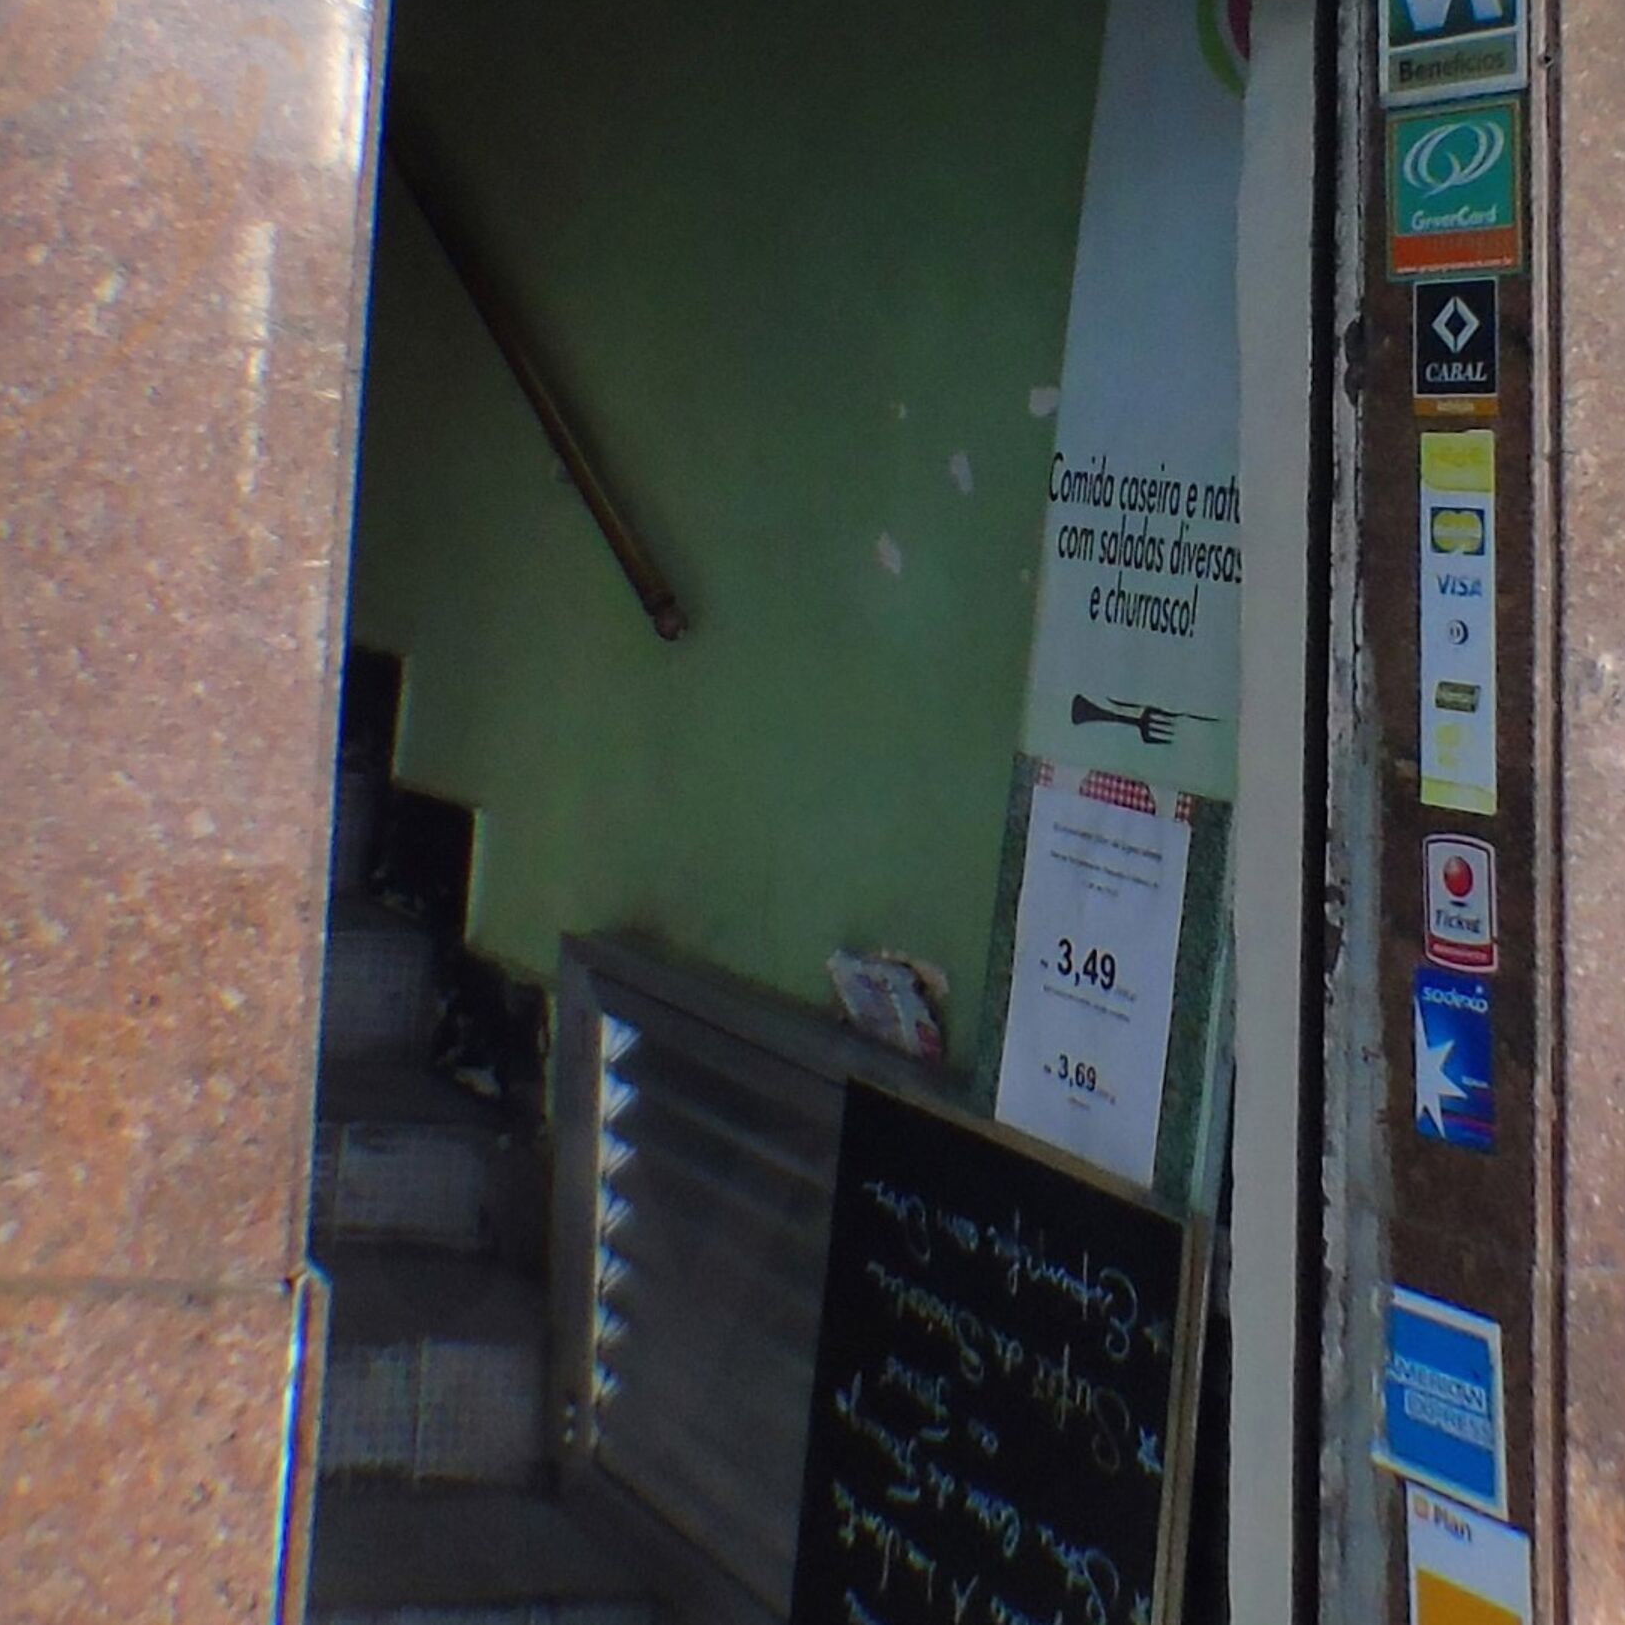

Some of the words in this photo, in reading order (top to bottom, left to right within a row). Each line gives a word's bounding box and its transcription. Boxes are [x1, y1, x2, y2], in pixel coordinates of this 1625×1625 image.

[1425, 361, 1488, 382] CABAL
[1049, 451, 1115, 508] Comida
[1119, 462, 1182, 516] caseira
[1186, 481, 1198, 519] e
[1058, 524, 1095, 561] com
[1099, 513, 1165, 573] saladas
[1089, 585, 1101, 621] e
[1105, 569, 1198, 638] churrasco!
[1437, 576, 1483, 597] VISA
[1057, 938, 1116, 990] 3,49
[1057, 1054, 1096, 1092] 3,69
